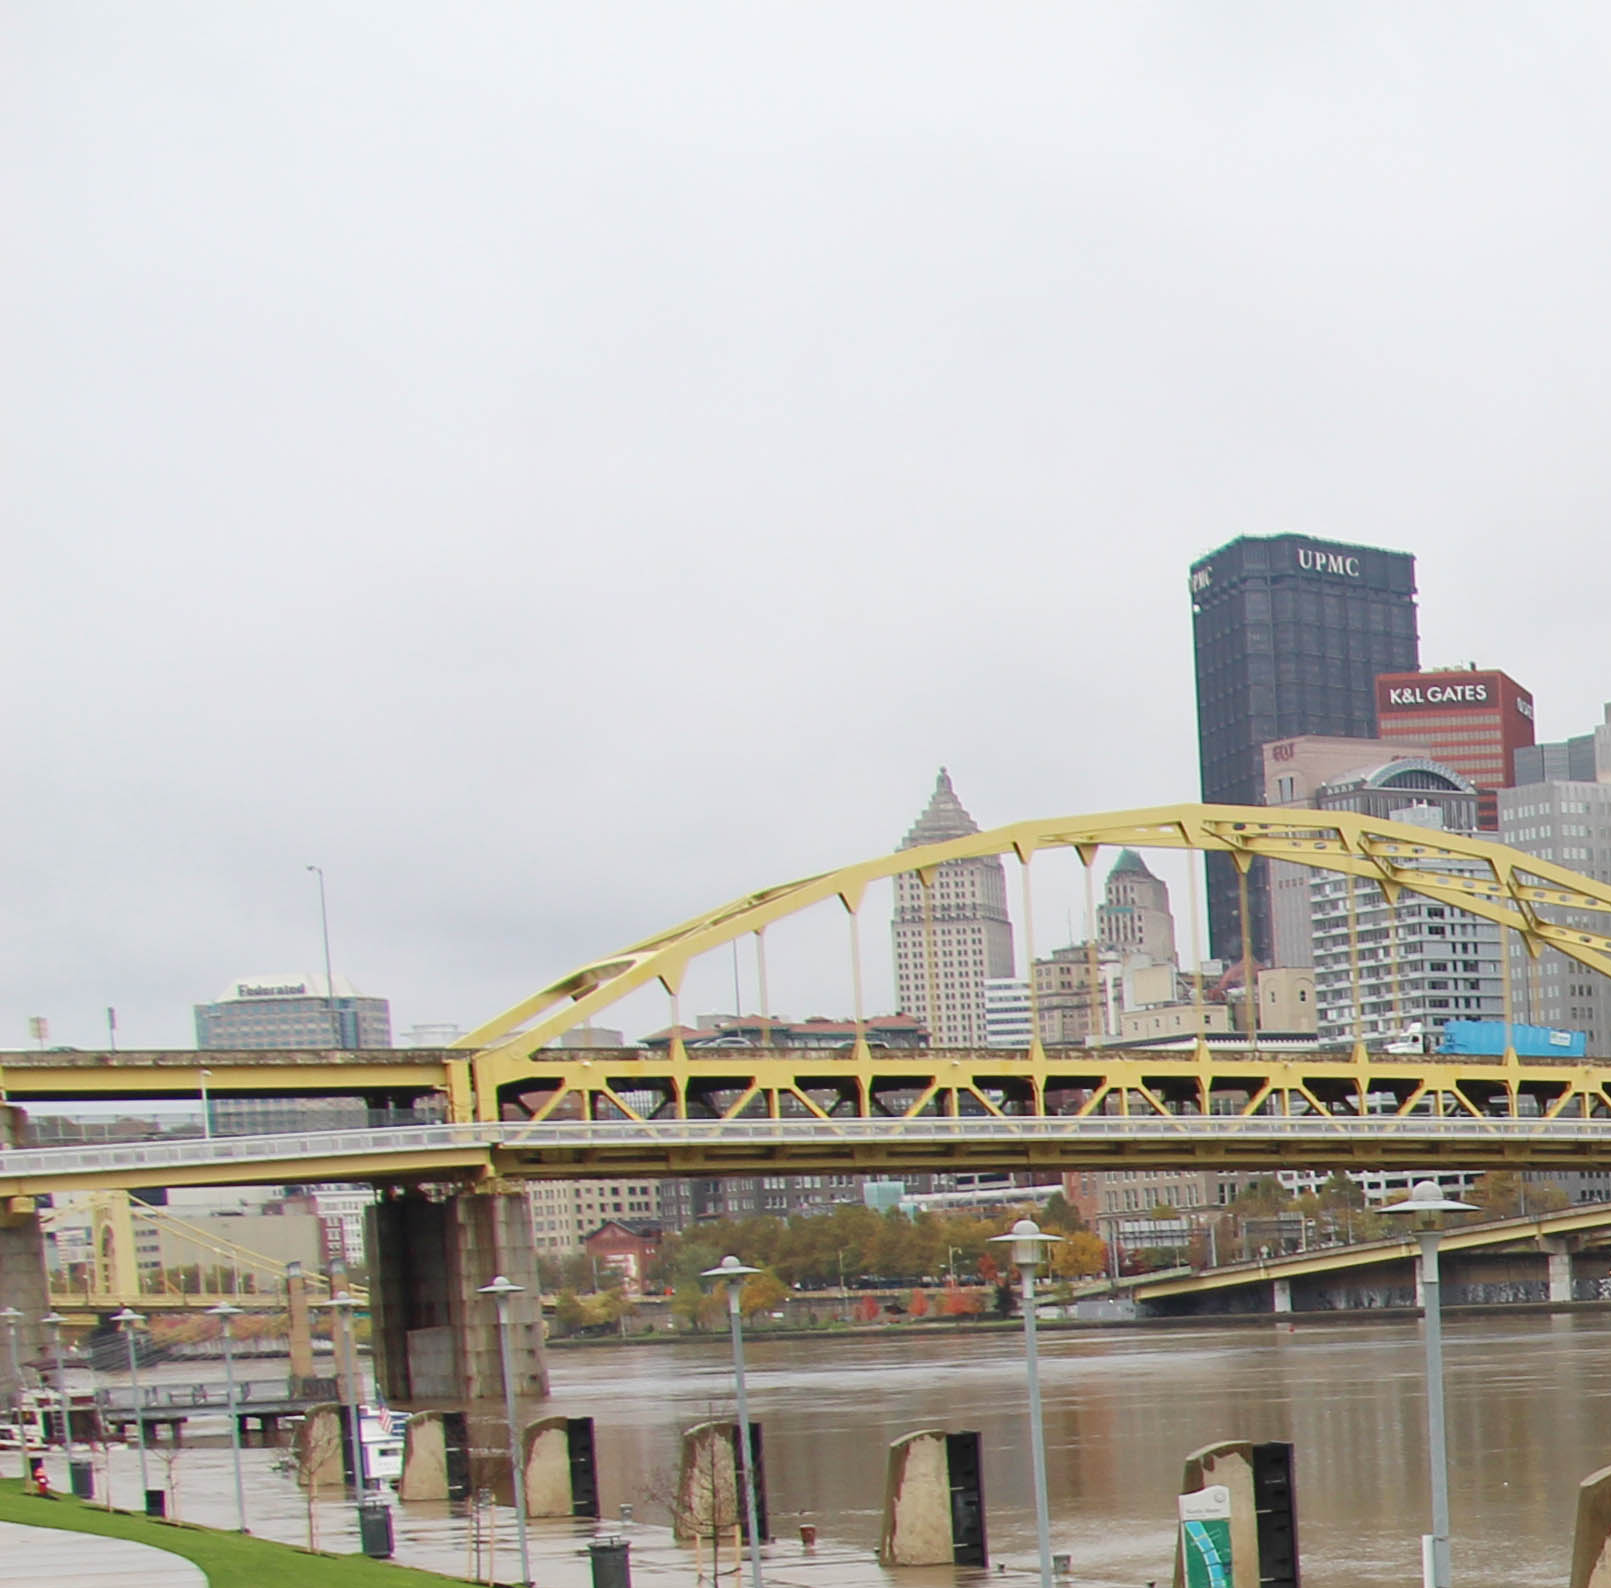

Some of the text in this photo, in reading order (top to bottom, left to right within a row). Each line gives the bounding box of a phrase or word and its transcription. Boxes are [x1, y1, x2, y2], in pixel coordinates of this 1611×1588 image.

[1297, 548, 1360, 577] UPMC
[1389, 684, 1487, 705] K&L GATES
[238, 983, 305, 997] Federated
